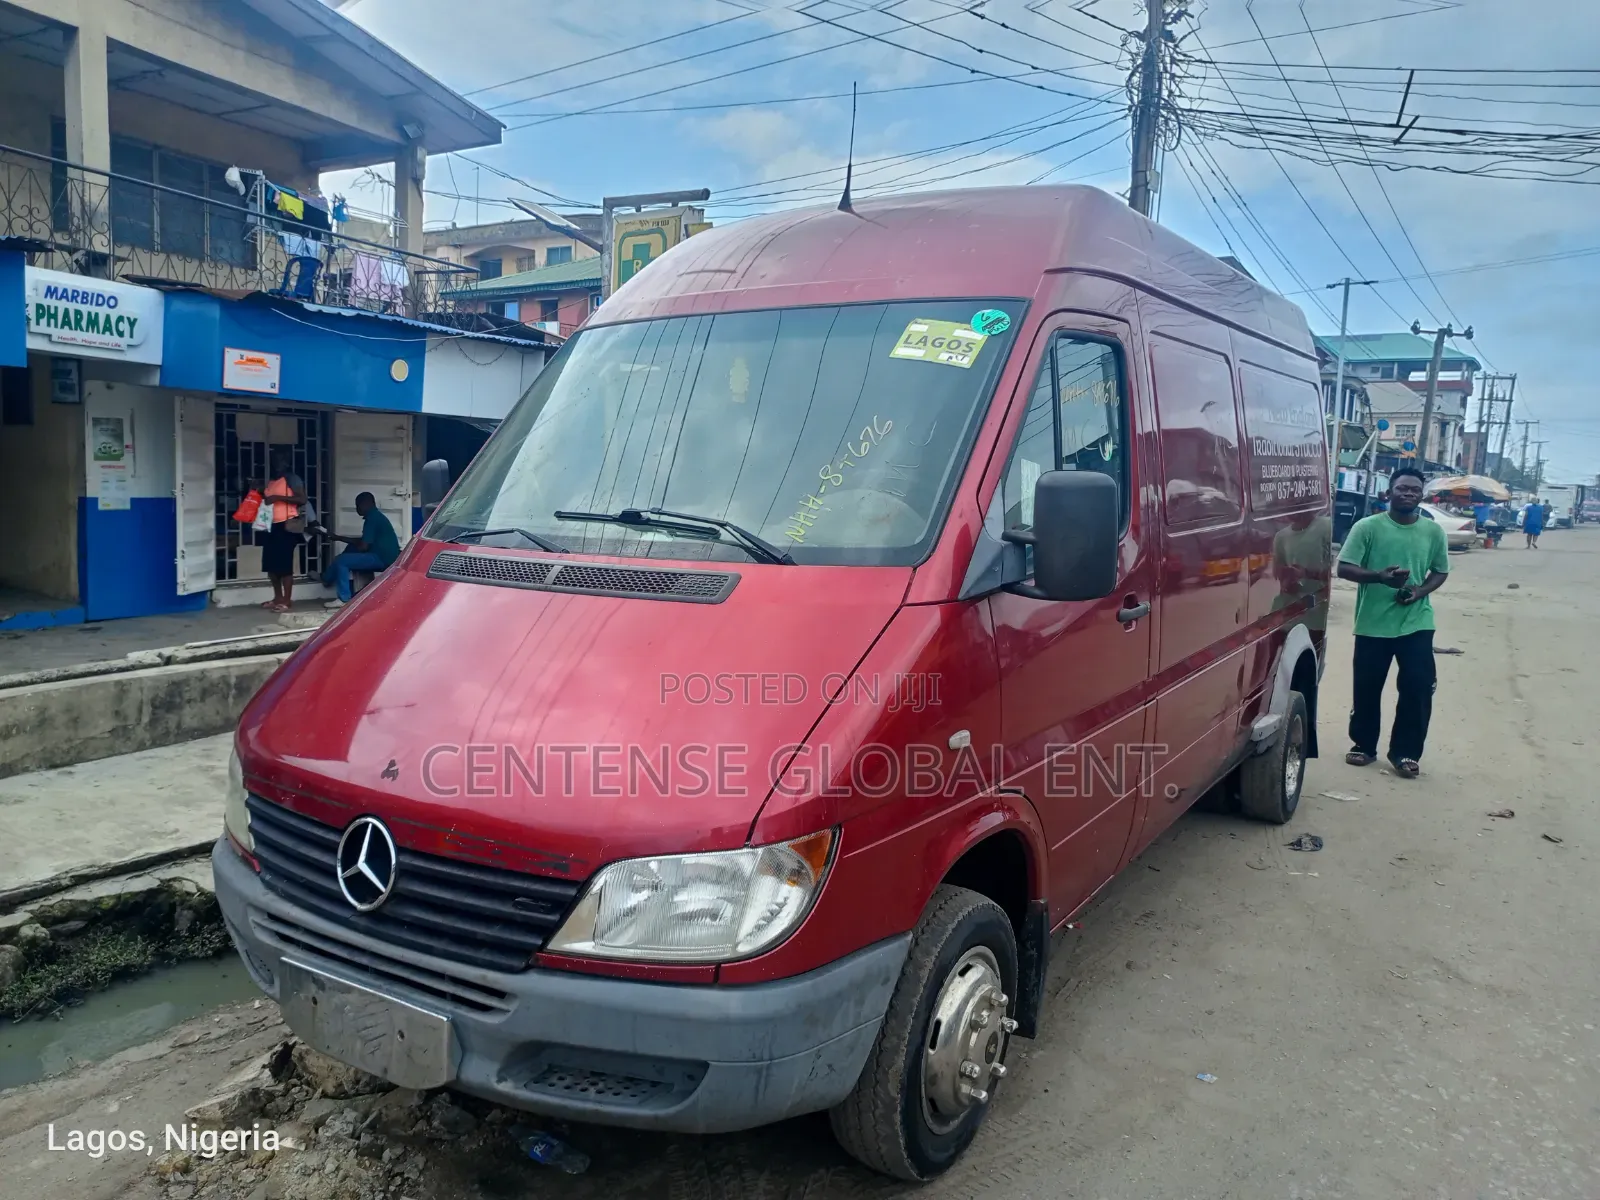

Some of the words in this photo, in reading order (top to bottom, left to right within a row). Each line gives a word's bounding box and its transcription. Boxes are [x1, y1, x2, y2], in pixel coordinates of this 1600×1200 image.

[44, 285, 118, 309] MARBIDO
[35, 302, 138, 339] PHARMACY
[902, 333, 977, 354] LAGOS
[1260, 482, 1277, 492] BOSTON
[1277, 480, 1322, 500] 857-249-5681
